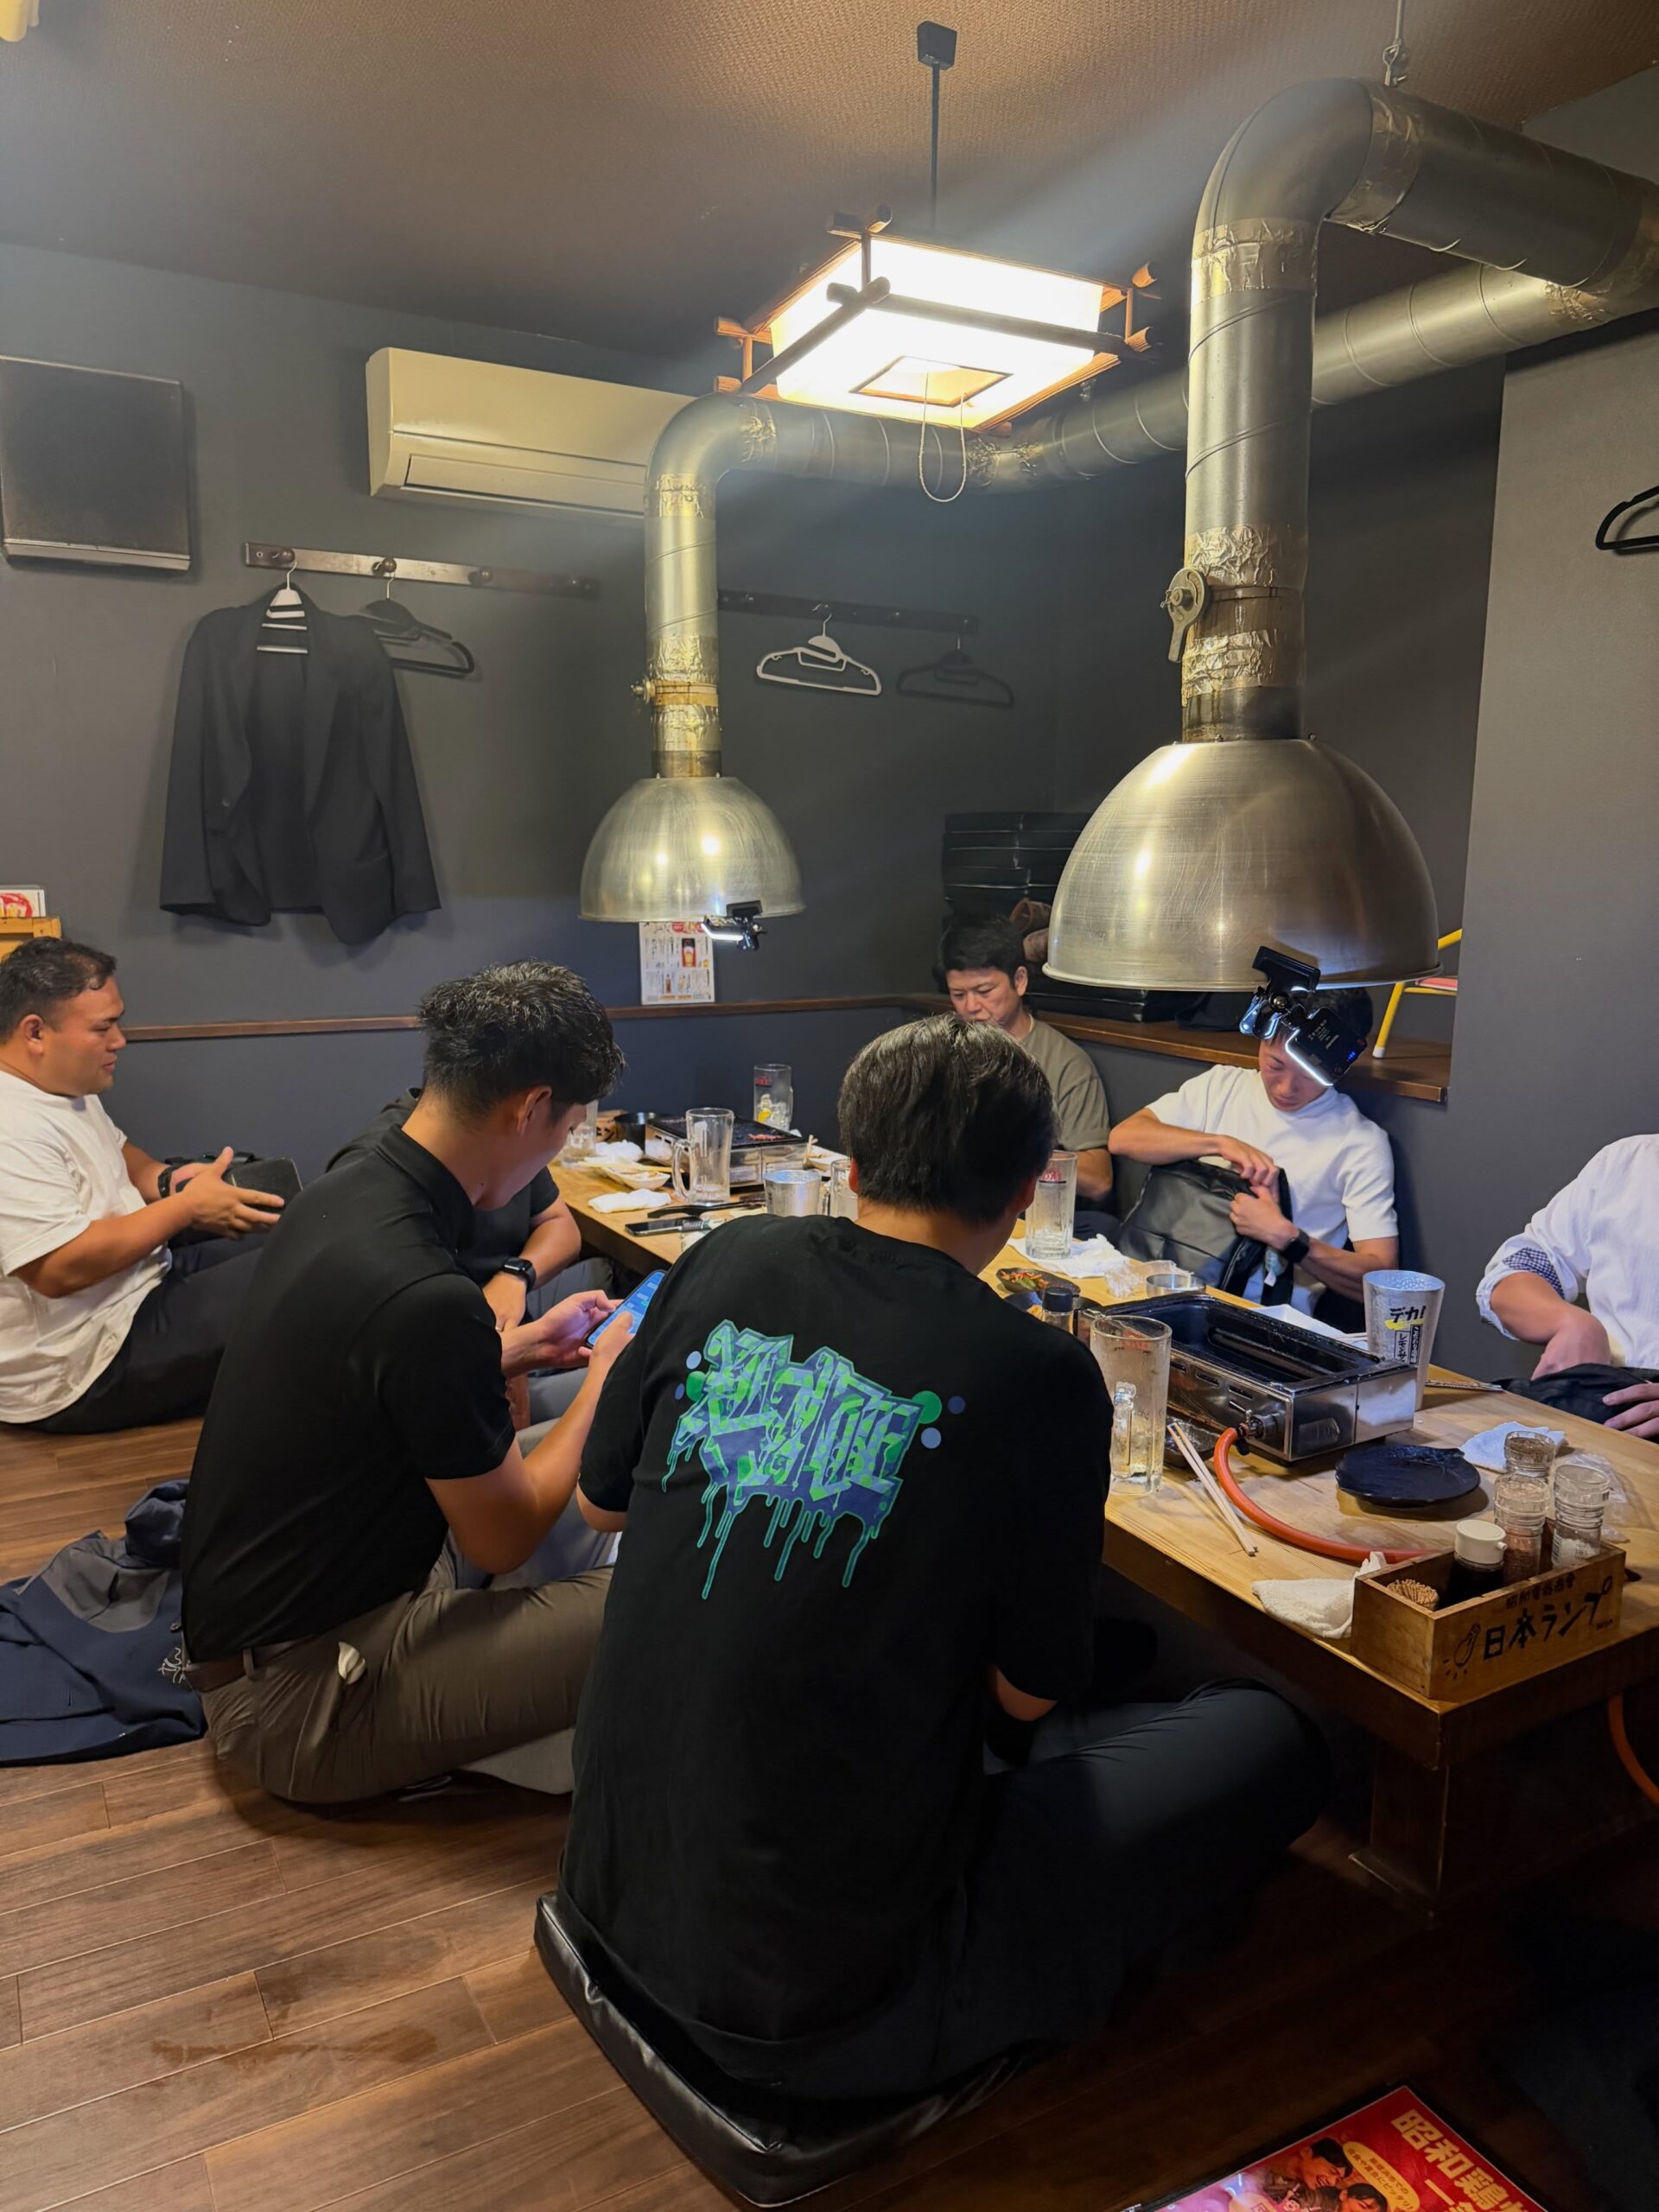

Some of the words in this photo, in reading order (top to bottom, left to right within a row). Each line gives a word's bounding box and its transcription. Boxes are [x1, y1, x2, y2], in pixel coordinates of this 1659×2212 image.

[1389, 1305, 1427, 1323] デカ!
[1484, 1575, 1612, 1659] 日本ランプ
